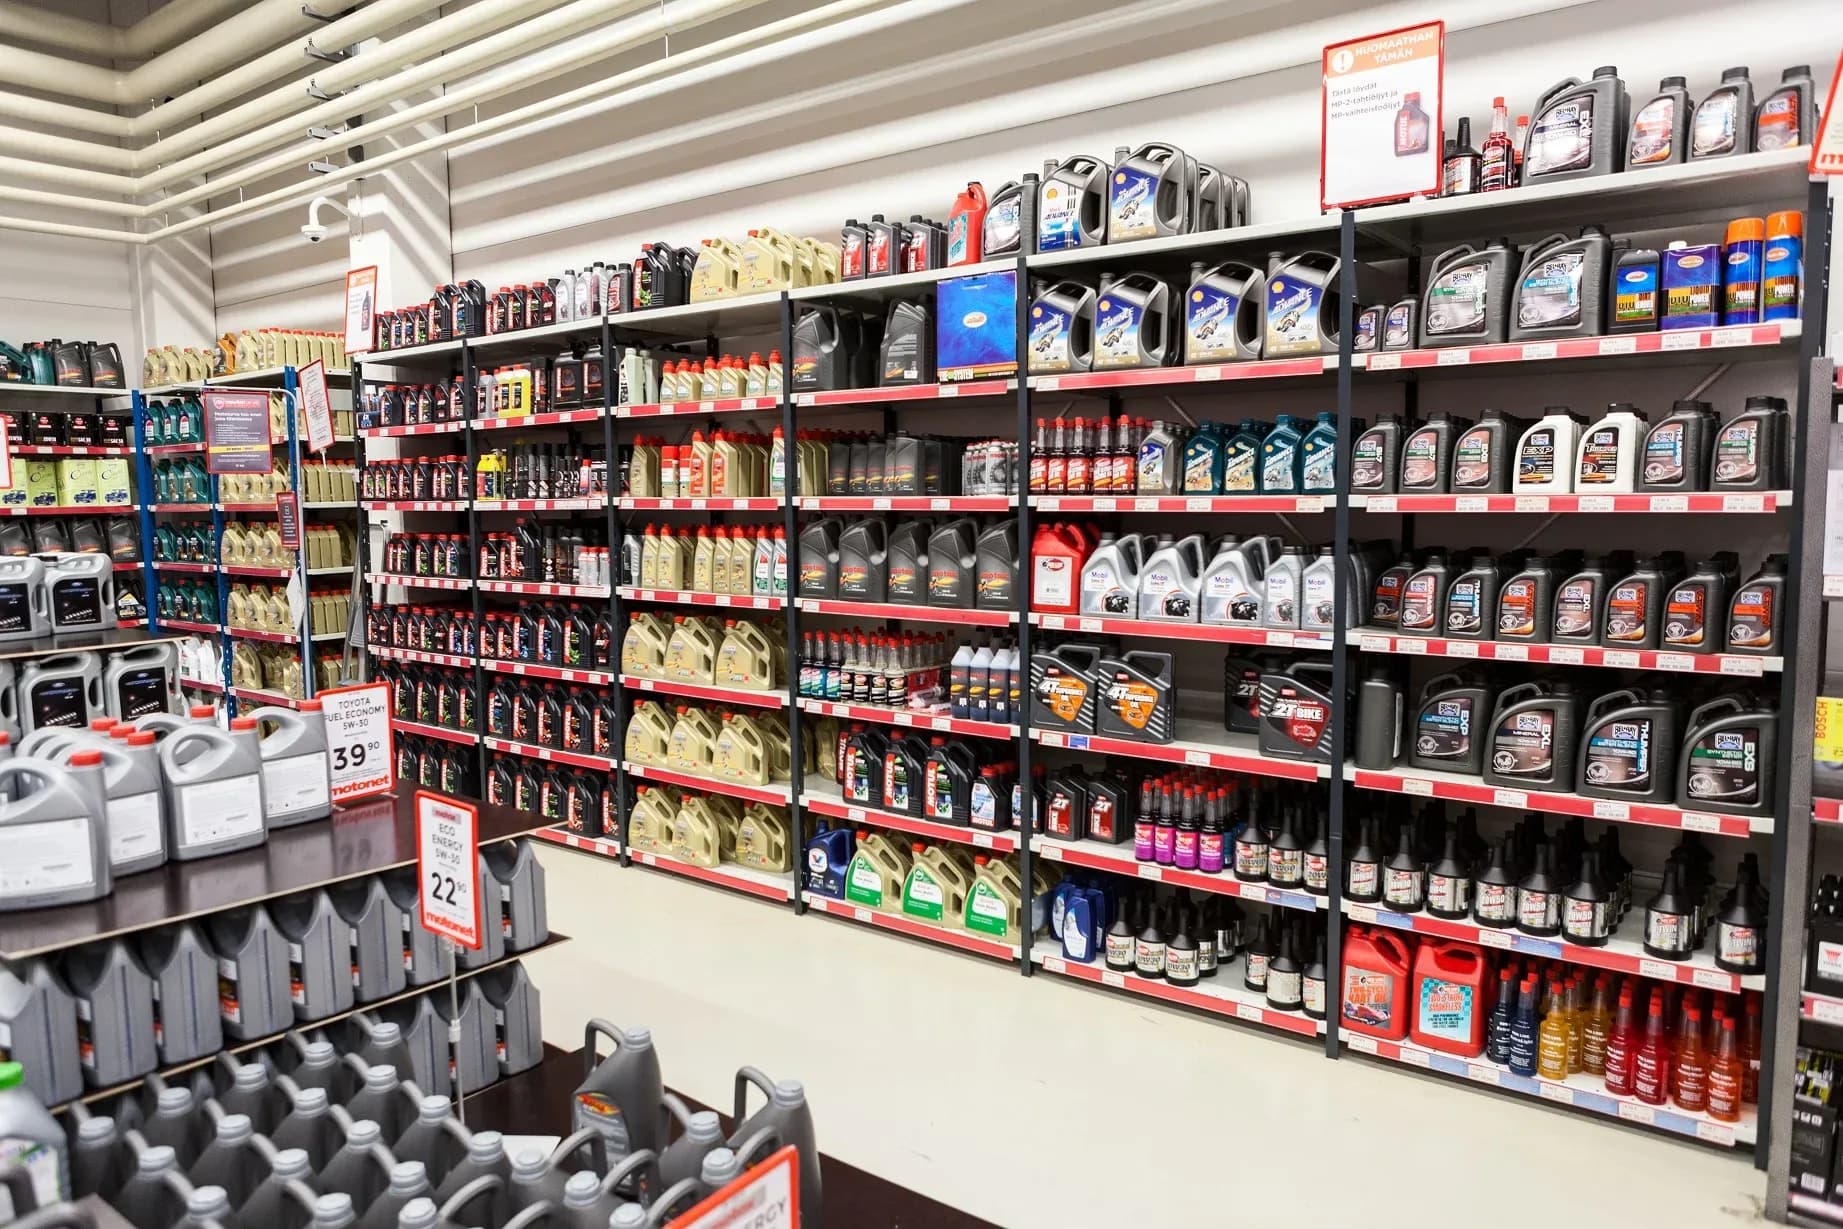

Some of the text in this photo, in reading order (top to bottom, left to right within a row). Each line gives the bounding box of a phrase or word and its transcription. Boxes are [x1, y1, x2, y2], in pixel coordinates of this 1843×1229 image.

[1355, 30, 1434, 56] HUOMAATHAN
[1375, 47, 1414, 64] TÄMÄN
[1353, 82, 1377, 94] löydät
[1331, 92, 1388, 109] MP-2-tahtiöljyt
[1400, 116, 1408, 147] MOTUL
[1579, 110, 1592, 138] EXL
[1690, 286, 1710, 295] LIQUID
[1775, 284, 1795, 297] POWER
[1272, 288, 1312, 315] ADVANCE
[1690, 294, 1710, 307] POWER
[1523, 446, 1554, 455] EXP
[1091, 571, 1108, 579] Mobil
[1151, 574, 1168, 582] Mobil
[1040, 681, 1060, 693] 4T
[1108, 686, 1129, 699] 4T
[1238, 684, 1258, 696] 2T
[339, 697, 371, 709] TOYOTA
[1268, 703, 1323, 720] 2T BIKE
[345, 705, 386, 719] ECONOMY
[1815, 701, 1828, 739] BOSCH
[343, 718, 369, 730] 5W-30
[1461, 710, 1469, 735] EXP
[1541, 724, 1551, 749] EXL
[333, 741, 380, 771] 39 90
[1744, 742, 1755, 771] EXS
[846, 752, 856, 790] MOTUL
[885, 758, 894, 797] MOTUL
[331, 774, 389, 796] motonet
[927, 767, 937, 808] MOTUL
[439, 823, 456, 836] ECO
[972, 818, 995, 827] MOTUL
[432, 834, 463, 852] ENERGY
[431, 871, 457, 906] 22
[426, 912, 474, 938] motonet
